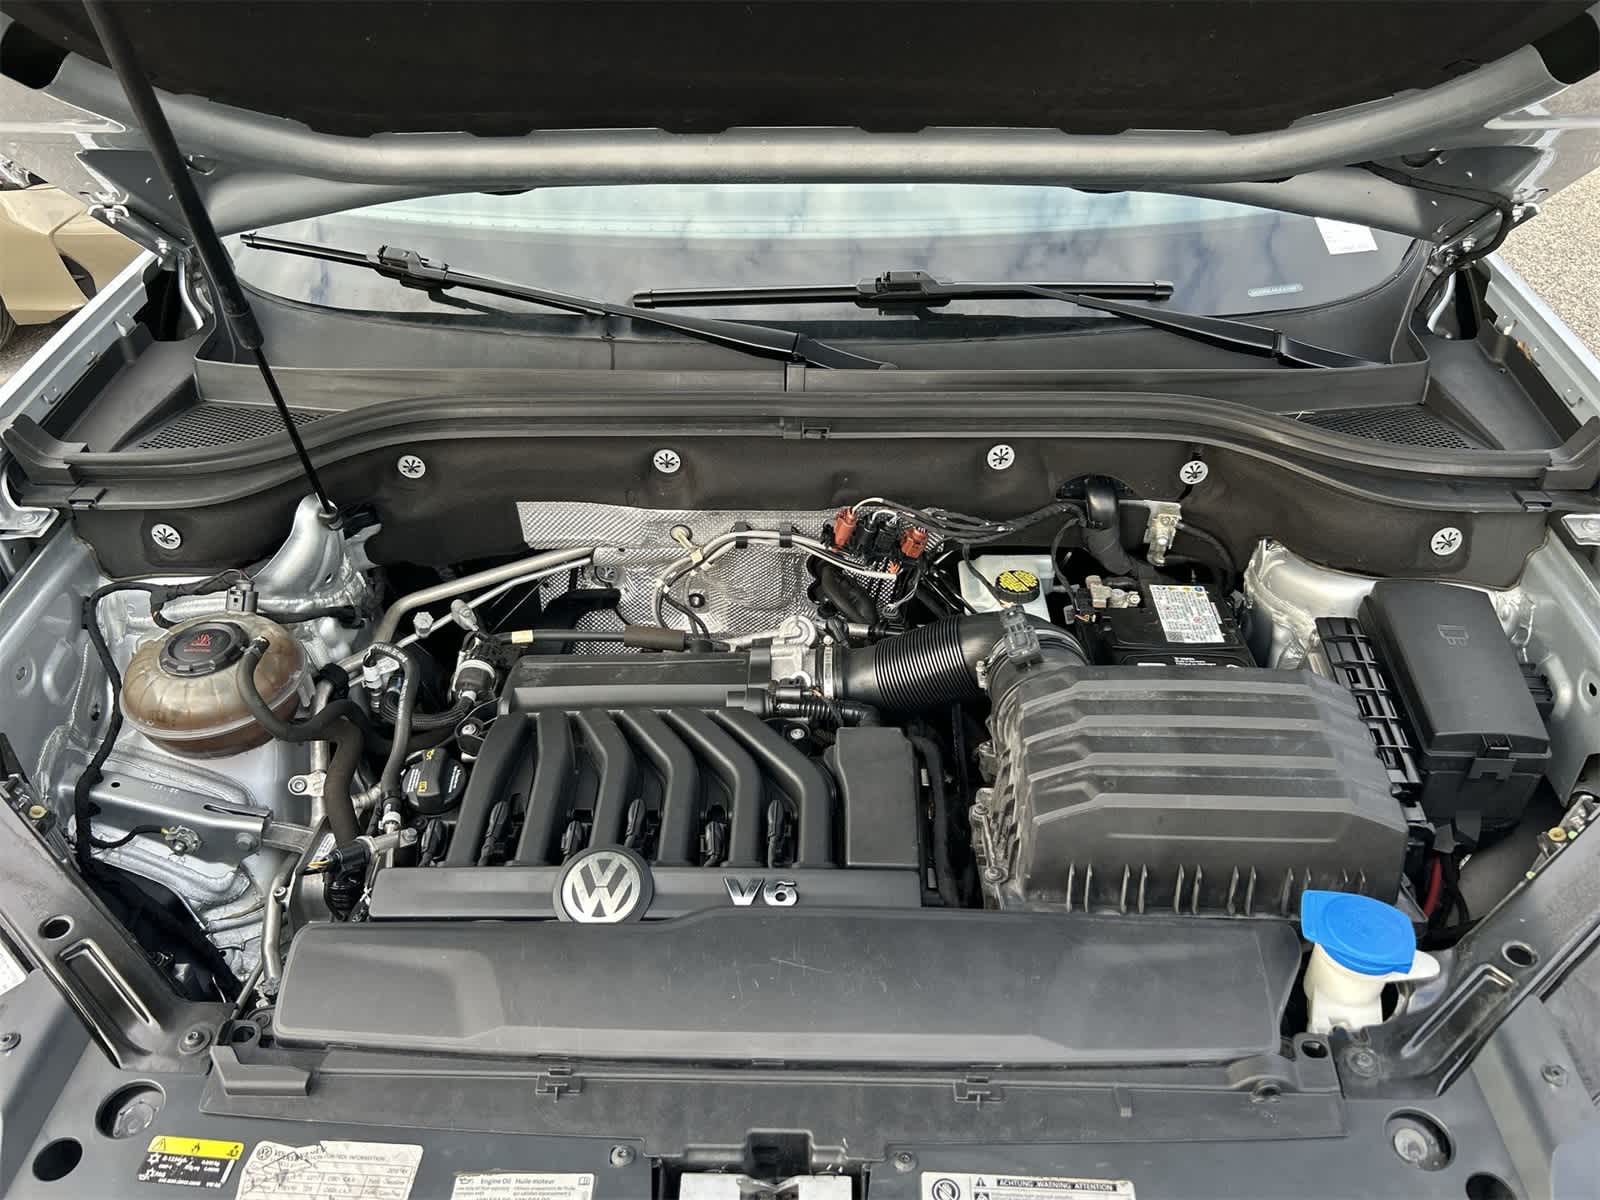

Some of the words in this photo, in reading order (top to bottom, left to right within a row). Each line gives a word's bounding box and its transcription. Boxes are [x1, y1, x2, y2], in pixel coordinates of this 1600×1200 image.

[561, 851, 641, 923] VW
[723, 877, 798, 906] V6
[480, 1178, 501, 1186] Engine
[999, 1178, 1034, 1187] ACHTUNG
[1036, 1180, 1071, 1189] WARNING
[1073, 1182, 1113, 1192] ATTENTION
